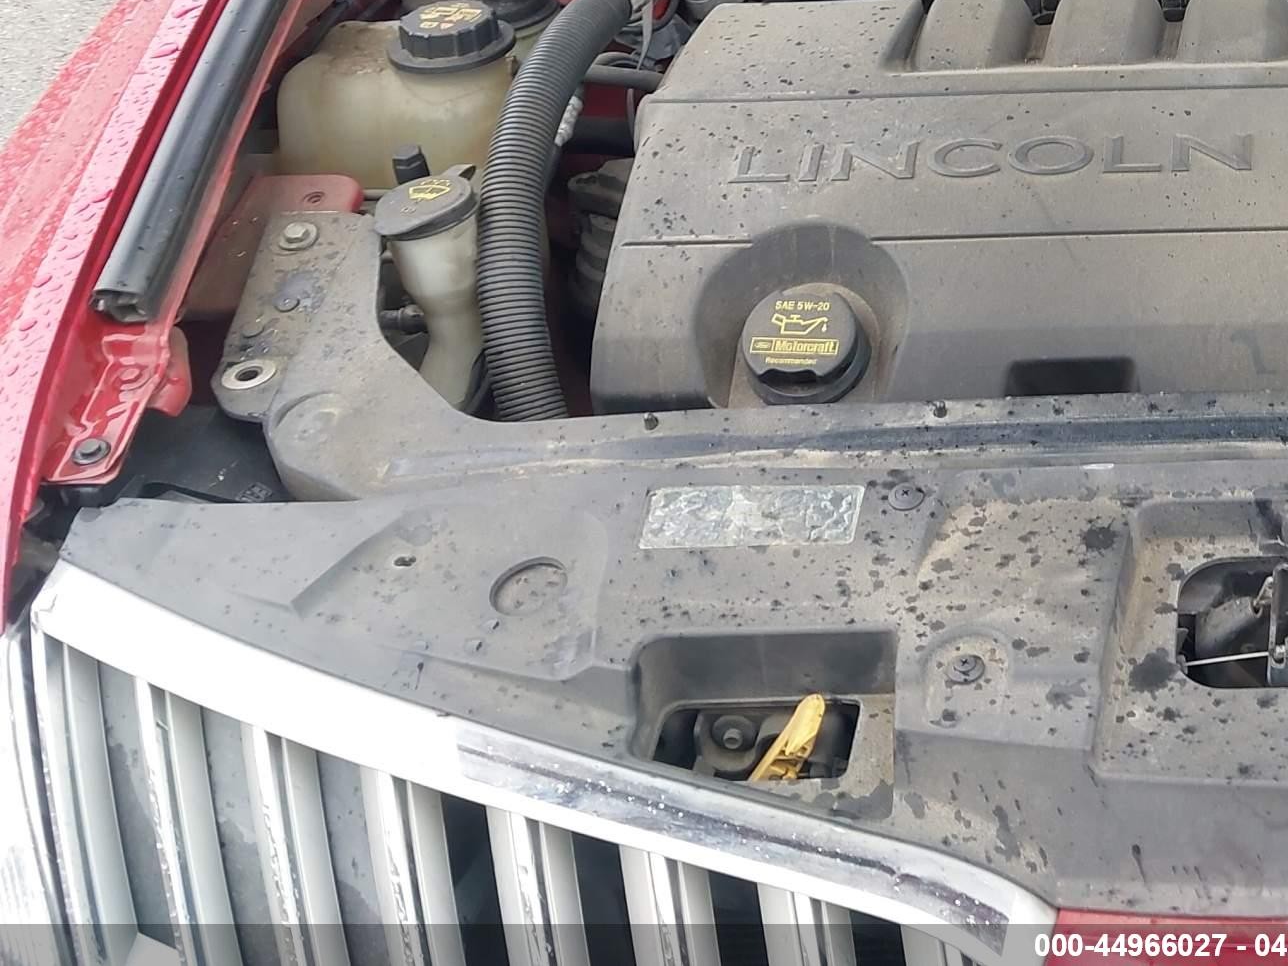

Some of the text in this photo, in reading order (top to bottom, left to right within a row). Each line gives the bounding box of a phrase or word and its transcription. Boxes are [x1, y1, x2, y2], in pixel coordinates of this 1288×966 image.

[727, 134, 1253, 184] LINCOLN
[775, 300, 830, 311] SAE 5W-20
[775, 340, 836, 353] Motorcraft
